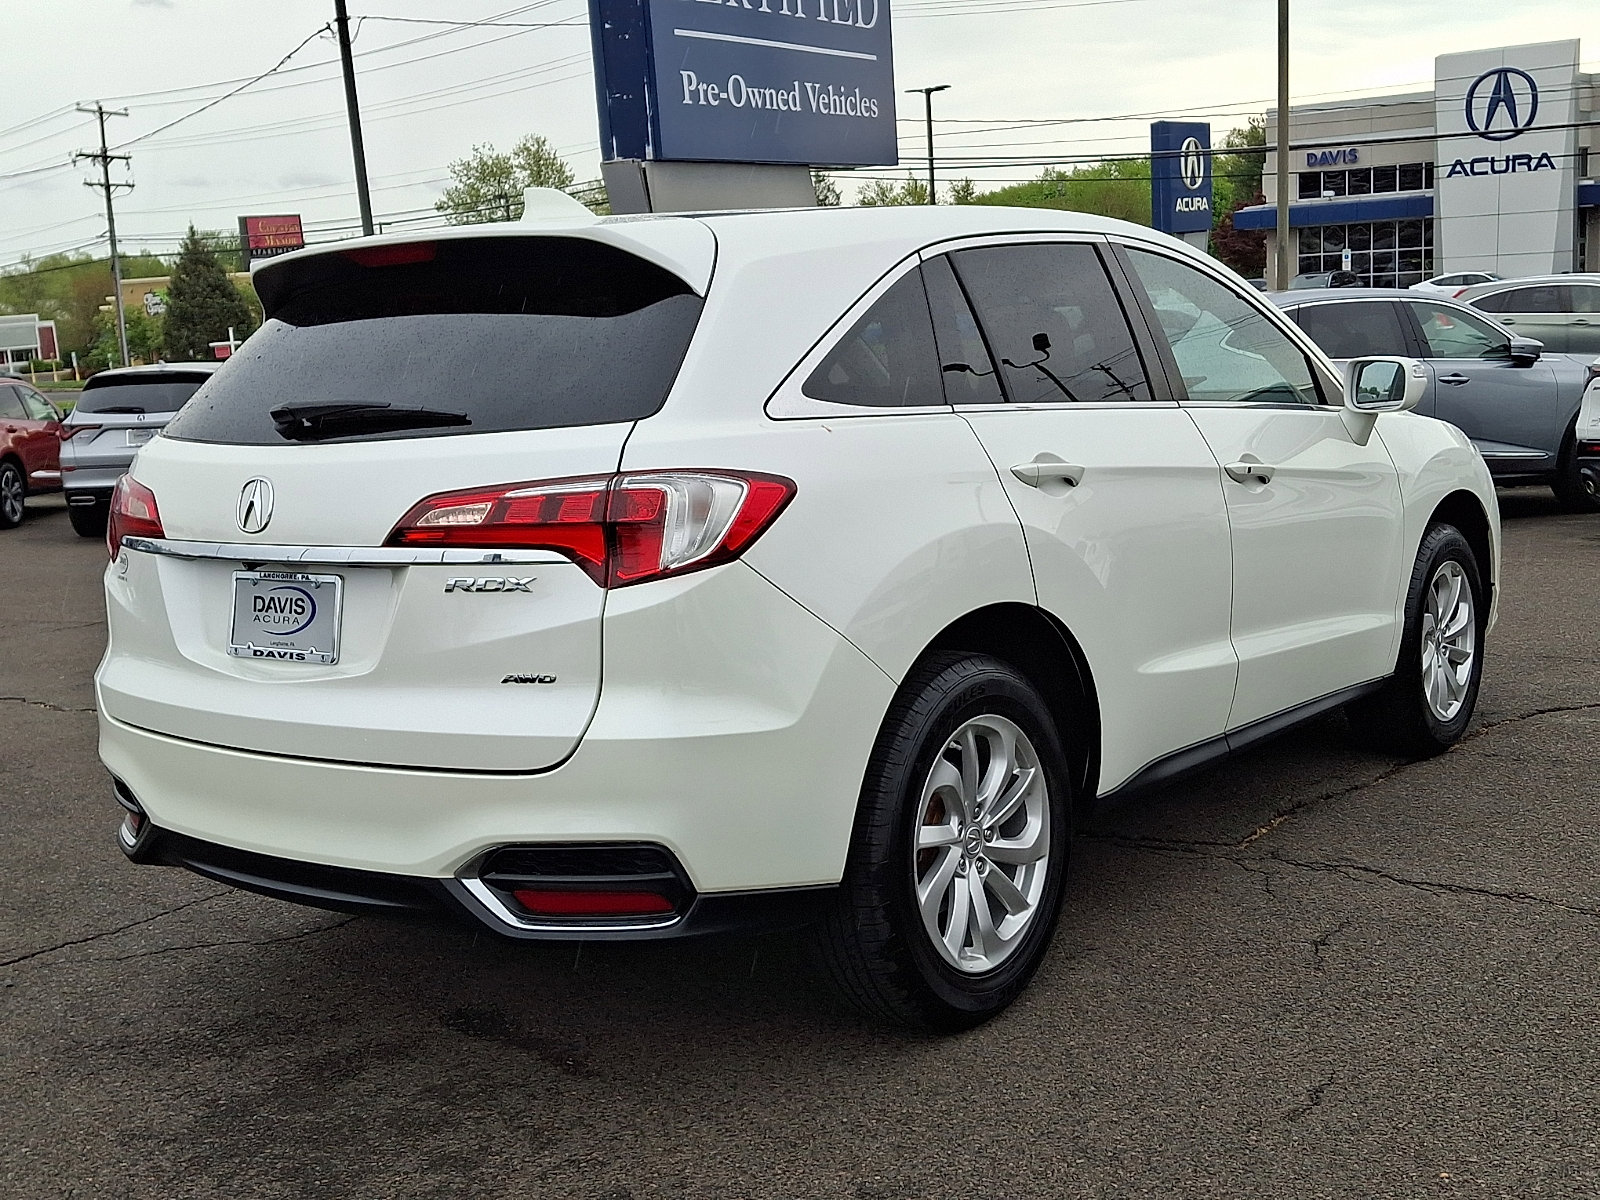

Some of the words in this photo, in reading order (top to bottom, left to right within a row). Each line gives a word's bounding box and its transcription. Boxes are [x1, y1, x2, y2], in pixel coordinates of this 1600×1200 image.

[679, 70, 801, 112] Pre-Owned
[804, 81, 878, 118] Vehicles
[1306, 148, 1358, 167] DAVIS
[1446, 152, 1557, 178] ACURA
[1176, 197, 1208, 212] ACURA
[444, 577, 538, 593] RDX
[253, 595, 306, 616] DAVIS
[253, 614, 300, 626] ACURA
[252, 649, 306, 661] DAVIS
[500, 673, 557, 684] AWD
